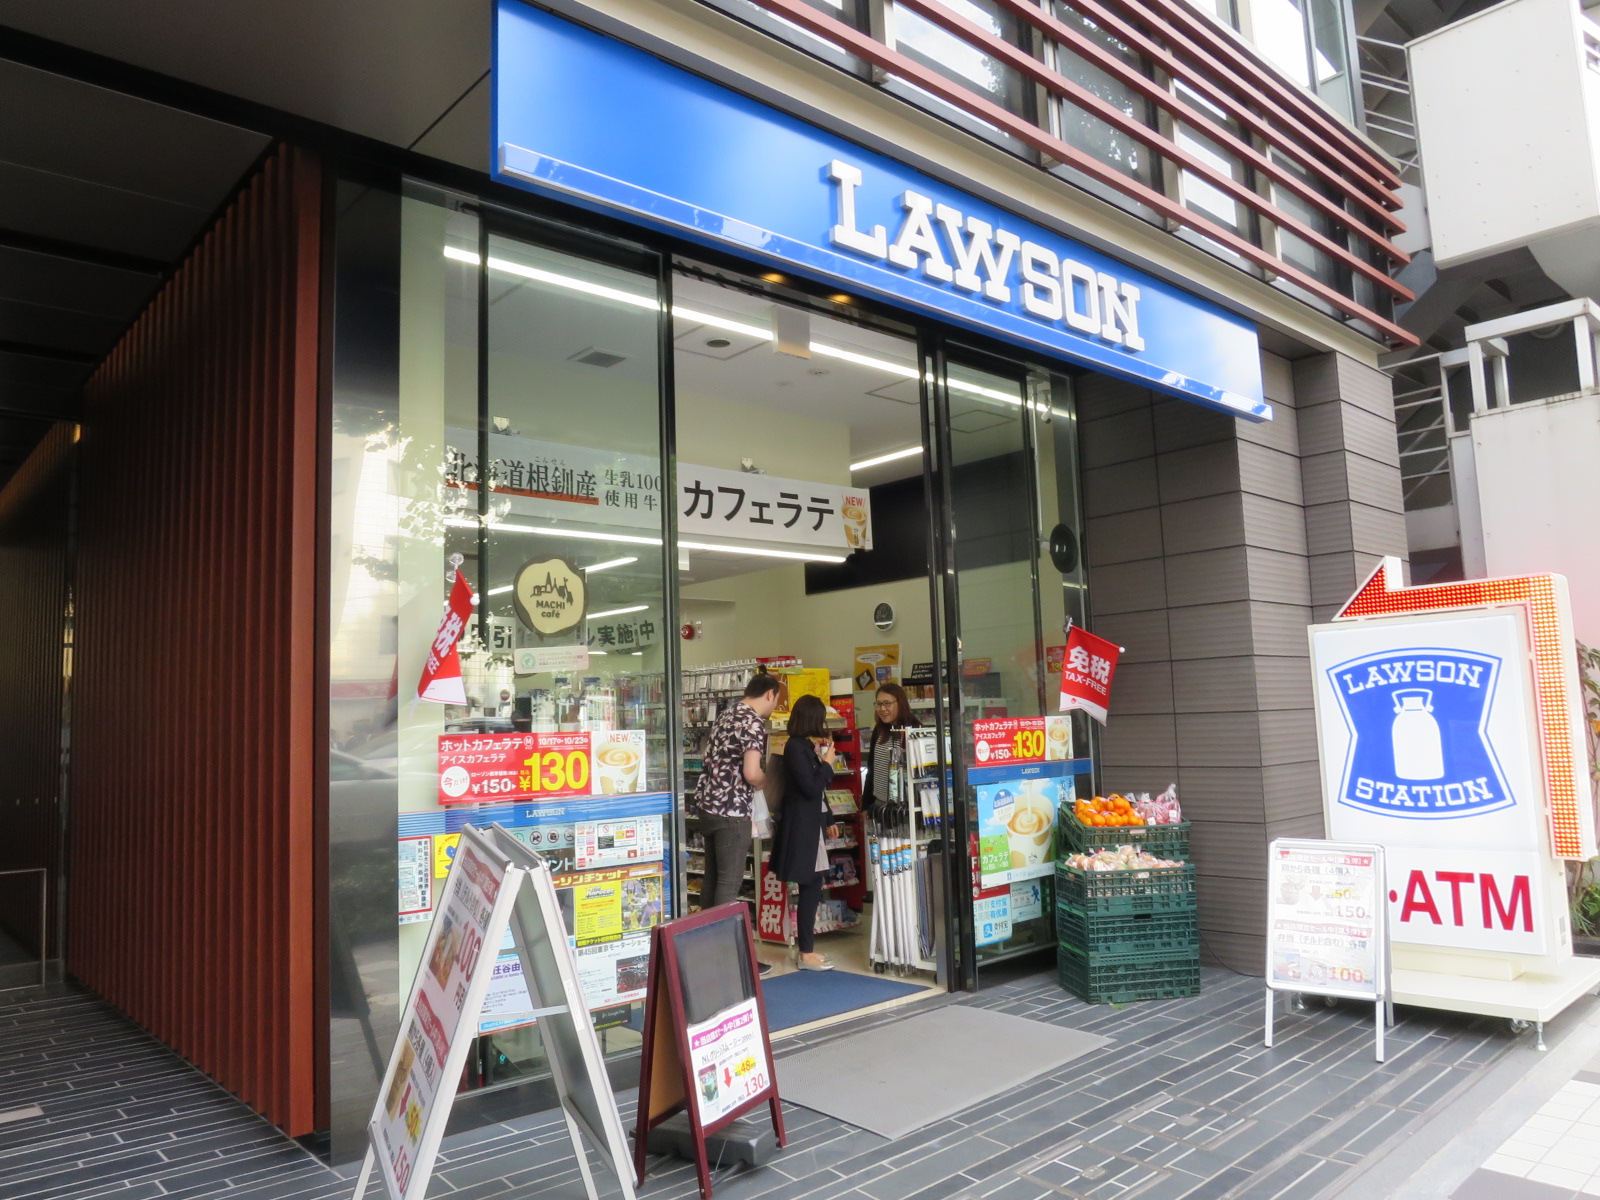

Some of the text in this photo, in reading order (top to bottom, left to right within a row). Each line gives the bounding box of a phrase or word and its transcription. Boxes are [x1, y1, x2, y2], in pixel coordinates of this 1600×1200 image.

[827, 159, 1145, 352] LAWSON
[684, 480, 834, 532] カフェラテ
[845, 496, 863, 506] NEW
[536, 600, 565, 610] MACHI
[541, 610, 560, 619] café
[1067, 645, 1110, 684] 免税
[1065, 670, 1107, 696] TAX-FREE
[1343, 660, 1483, 695] LAWSON
[975, 721, 1013, 731] ホットカフェラテ
[441, 738, 523, 752] ホットカフェラテ
[610, 733, 629, 743] NEW
[441, 753, 506, 765] アイスカフェラテ
[519, 751, 589, 791] ¥130
[472, 778, 512, 795] ¥150
[1355, 777, 1493, 807] STATION
[526, 808, 565, 818] LAWSON
[982, 851, 1009, 864] カフェラテ
[761, 871, 783, 935] 免税
[1400, 869, 1534, 933] ATM
[1336, 905, 1366, 919] 150
[455, 921, 481, 982] 100
[1329, 966, 1364, 983] 100
[744, 1073, 764, 1097] 130
[393, 1146, 410, 1193] 150
